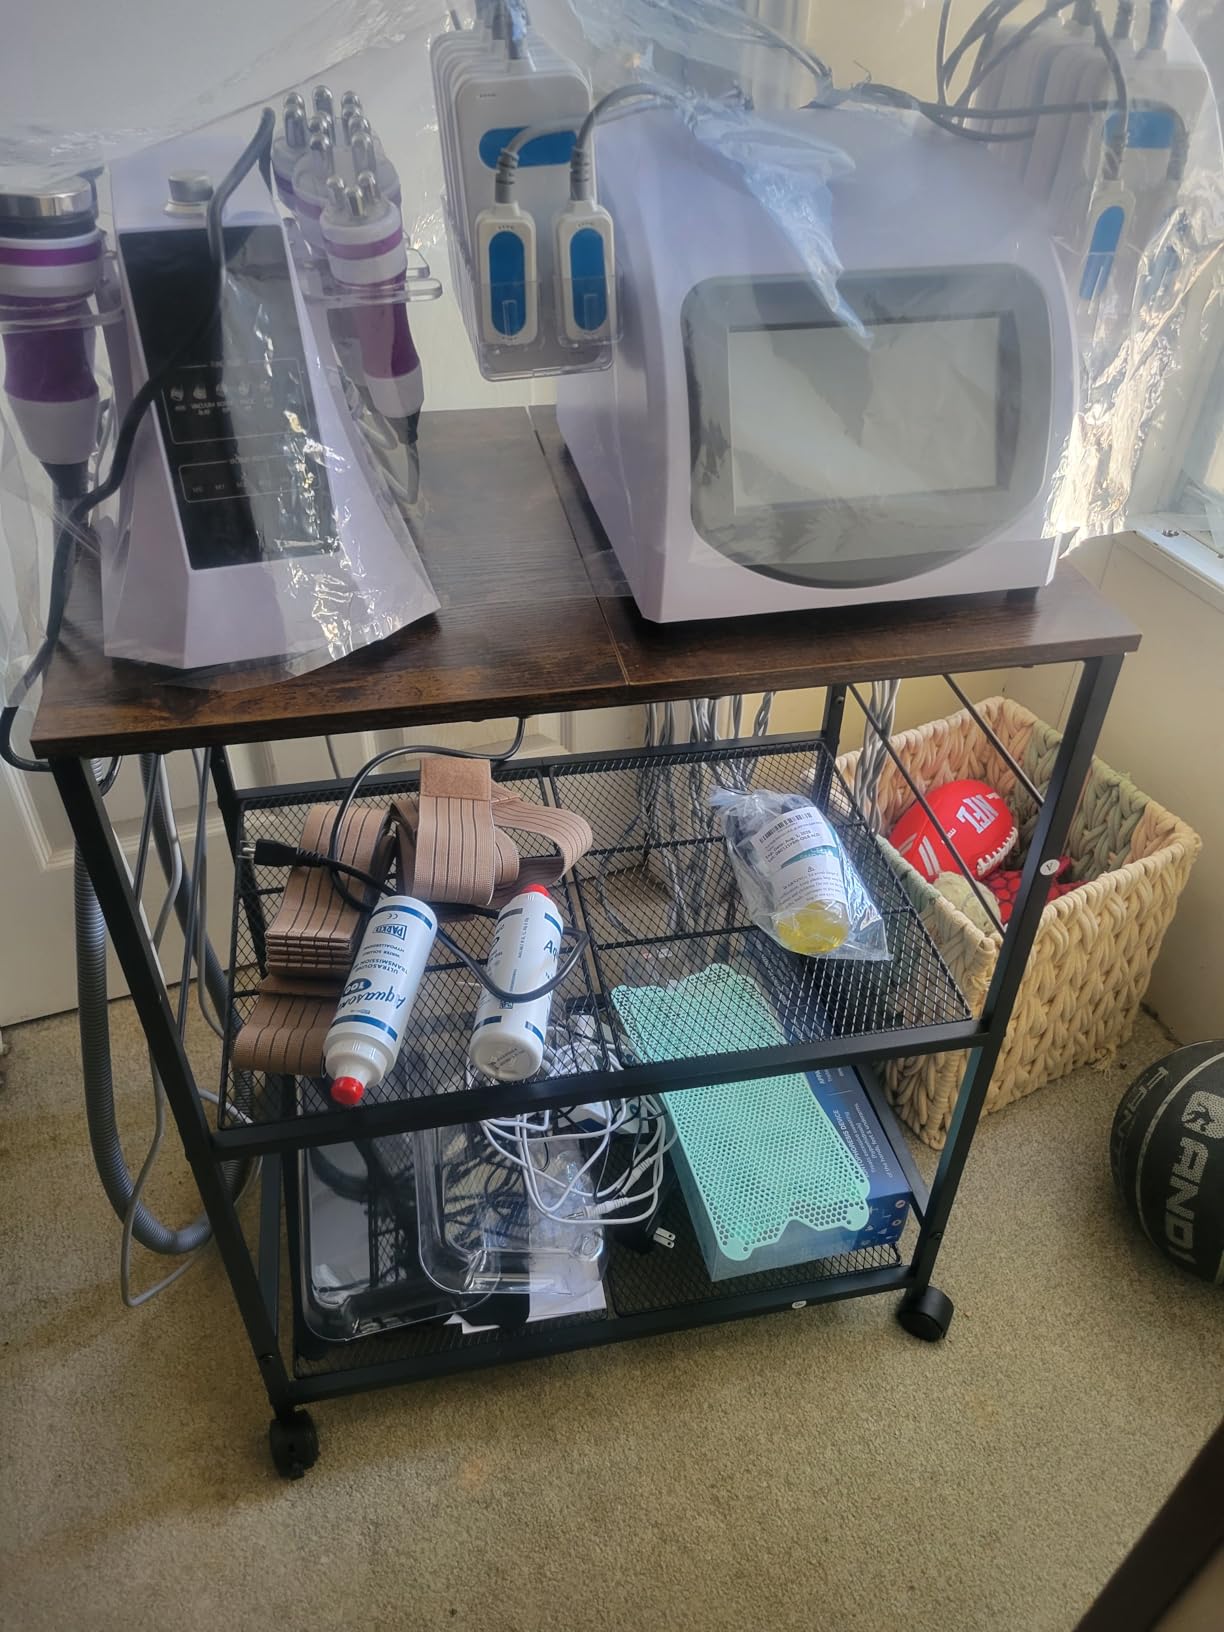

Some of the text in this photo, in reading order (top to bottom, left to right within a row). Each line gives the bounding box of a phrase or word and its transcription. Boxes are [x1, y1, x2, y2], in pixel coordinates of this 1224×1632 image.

[956, 794, 998, 834] NFL
[360, 960, 407, 974] TRANSMISSION
[833, 1109, 846, 1130] DEVICE
[869, 1134, 877, 1145] feet
[1165, 1136, 1208, 1264] AND1
